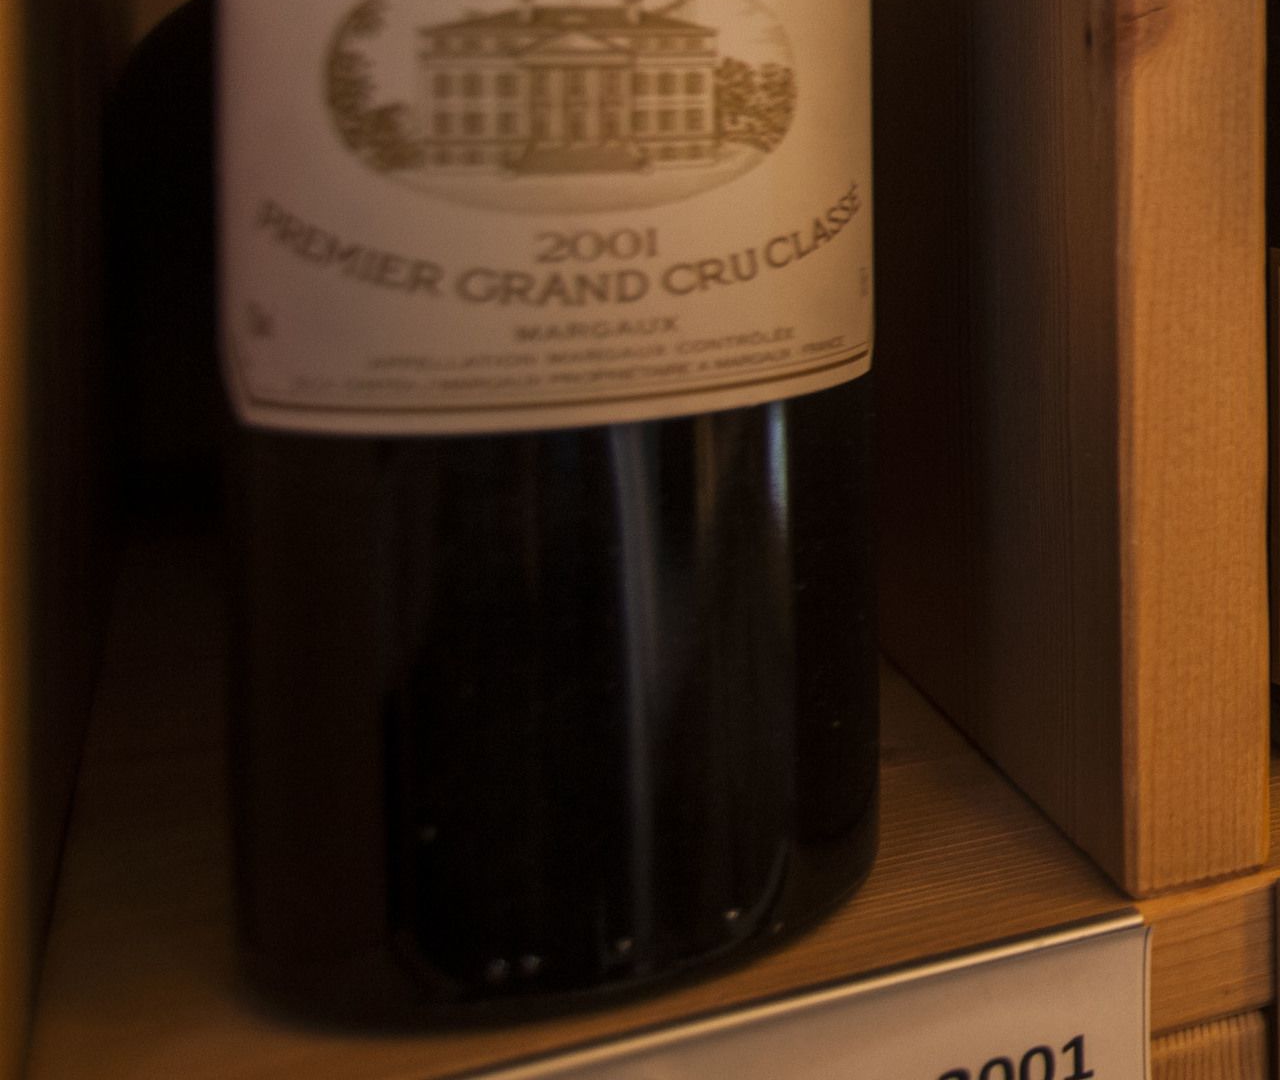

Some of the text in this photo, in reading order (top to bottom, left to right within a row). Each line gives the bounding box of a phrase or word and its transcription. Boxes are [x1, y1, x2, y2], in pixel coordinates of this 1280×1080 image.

[254, 198, 443, 296] PREMIER
[454, 266, 651, 308] GRAND
[662, 248, 760, 298] CRU
[533, 227, 658, 265] 2001
[513, 317, 678, 344] MARGAUX
[936, 1033, 1095, 1080] 001
